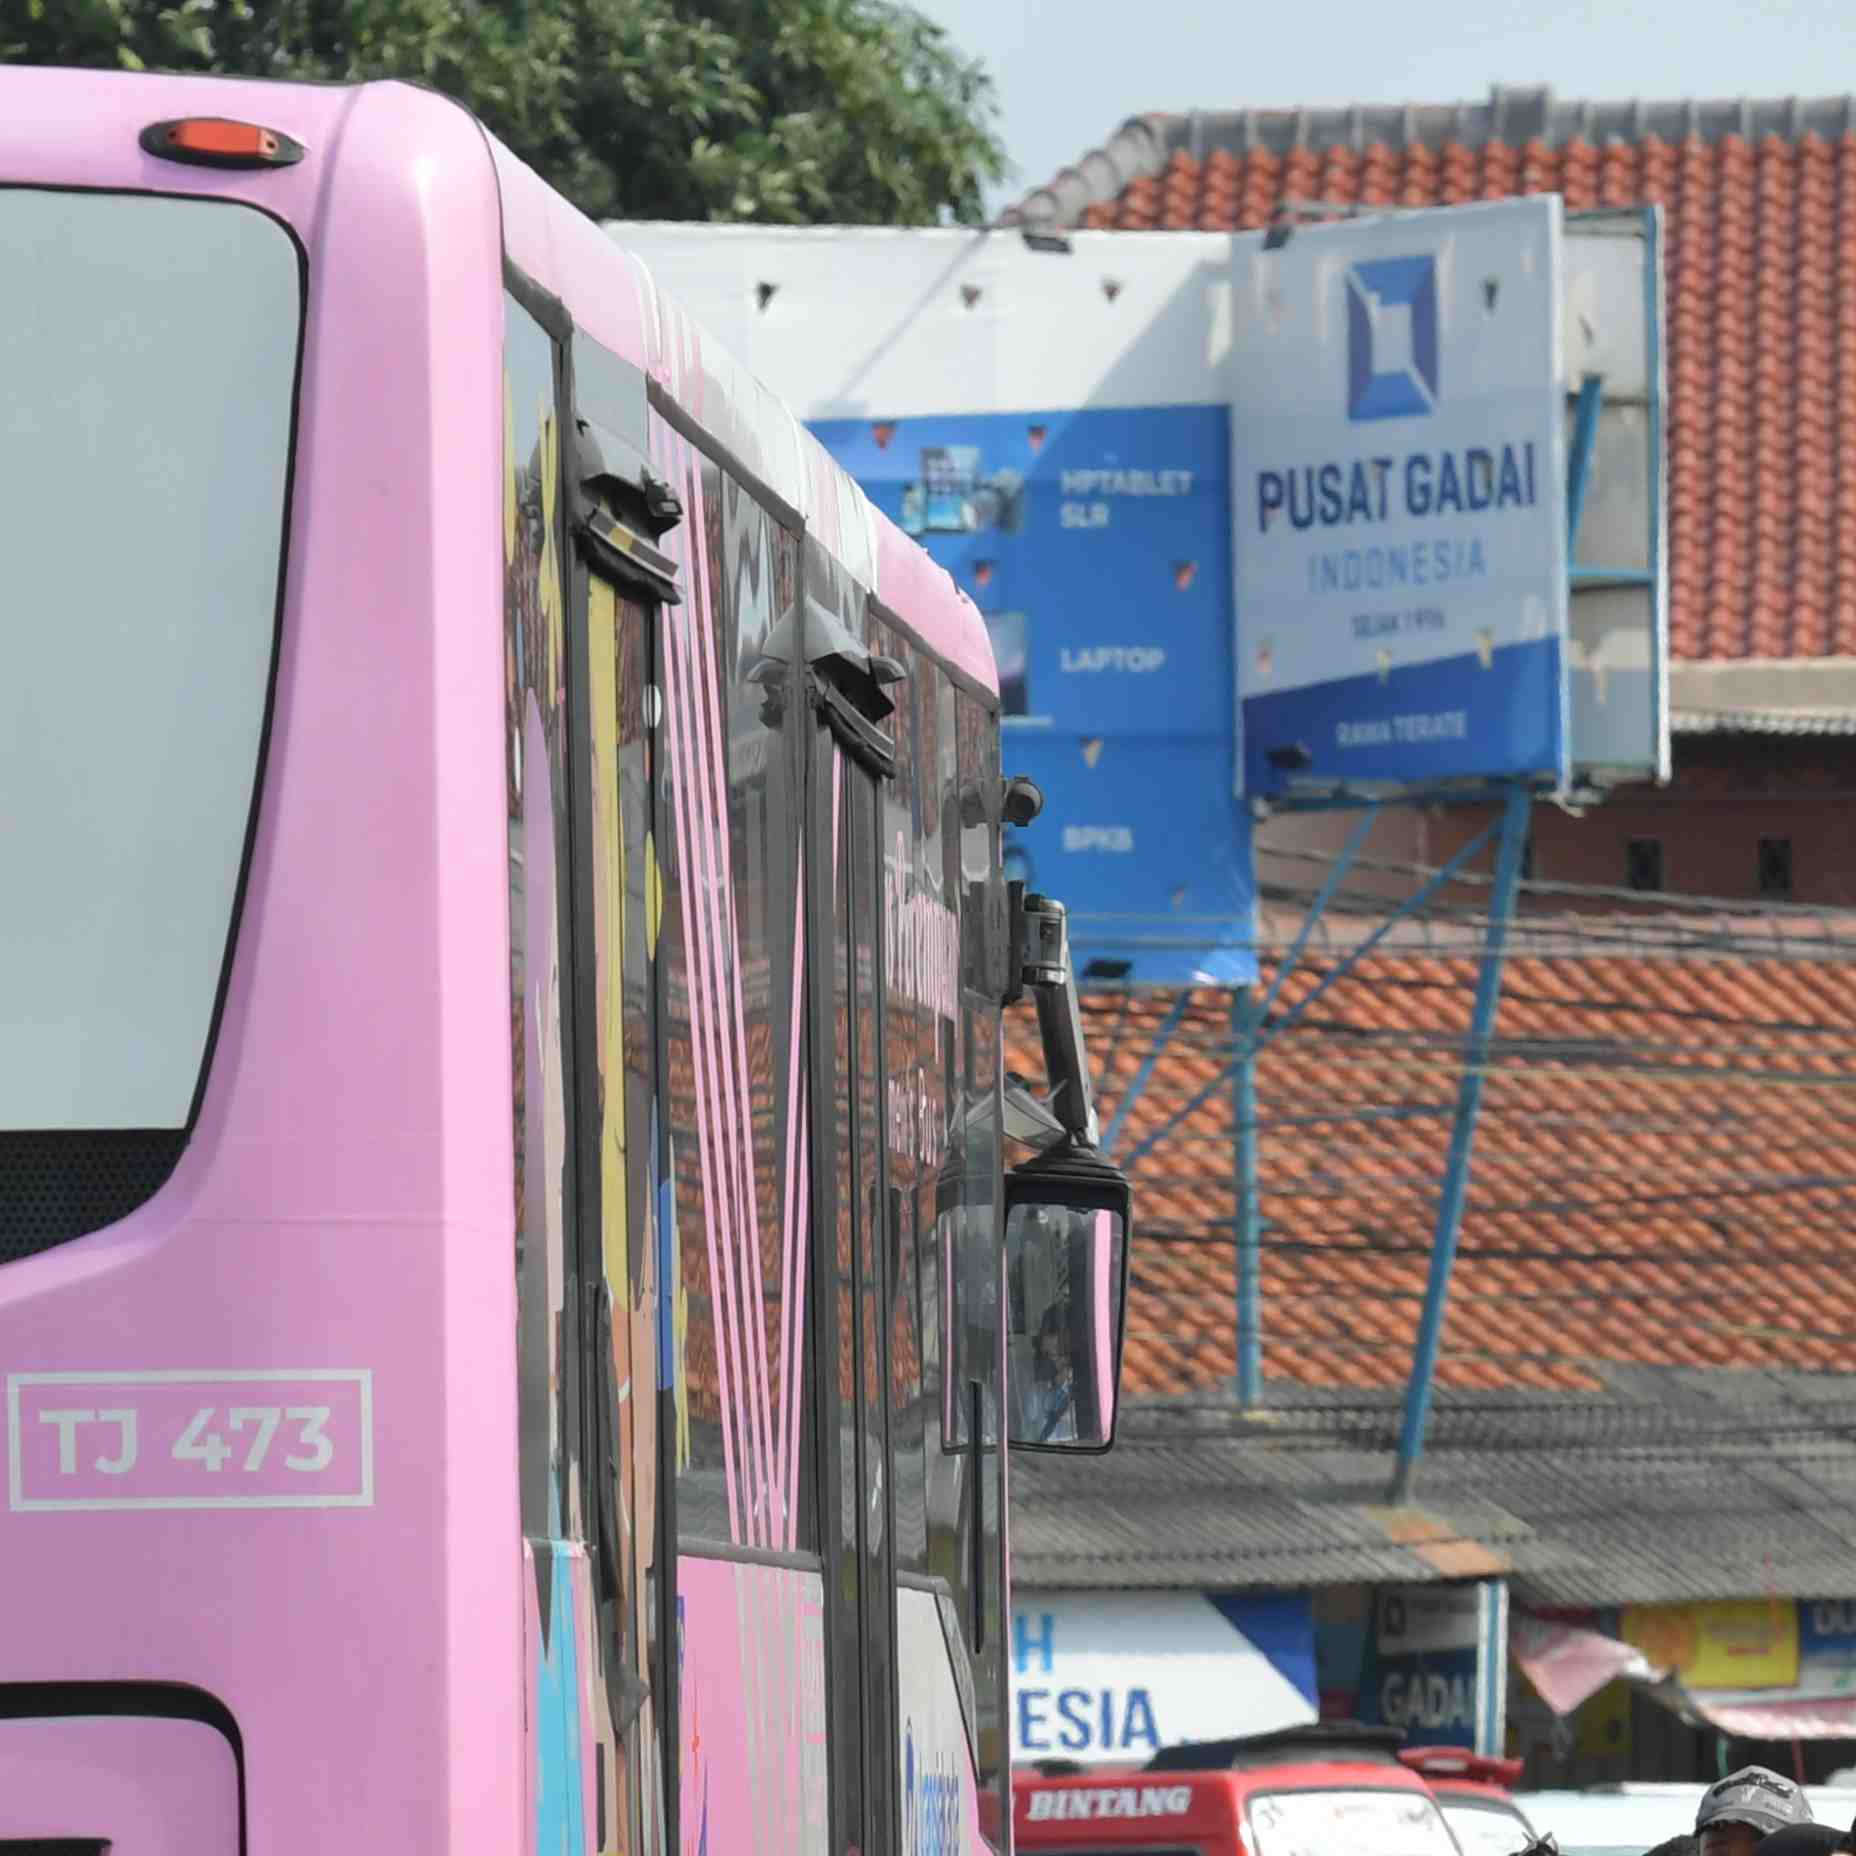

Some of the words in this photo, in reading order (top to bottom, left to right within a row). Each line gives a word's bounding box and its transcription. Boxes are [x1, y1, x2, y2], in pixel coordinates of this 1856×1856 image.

[1256, 456, 1393, 534] PUSAT
[1405, 442, 1536, 517] GADAI
[1308, 537, 1487, 593] INDONESIA
[1060, 646, 1166, 673] LAPTOP
[1063, 826, 1134, 853] BPKB
[39, 1406, 140, 1475] TJ
[170, 1404, 335, 1474] 473
[1016, 1689, 1162, 1751] ESIA
[1026, 1786, 1194, 1822] BINTANG
